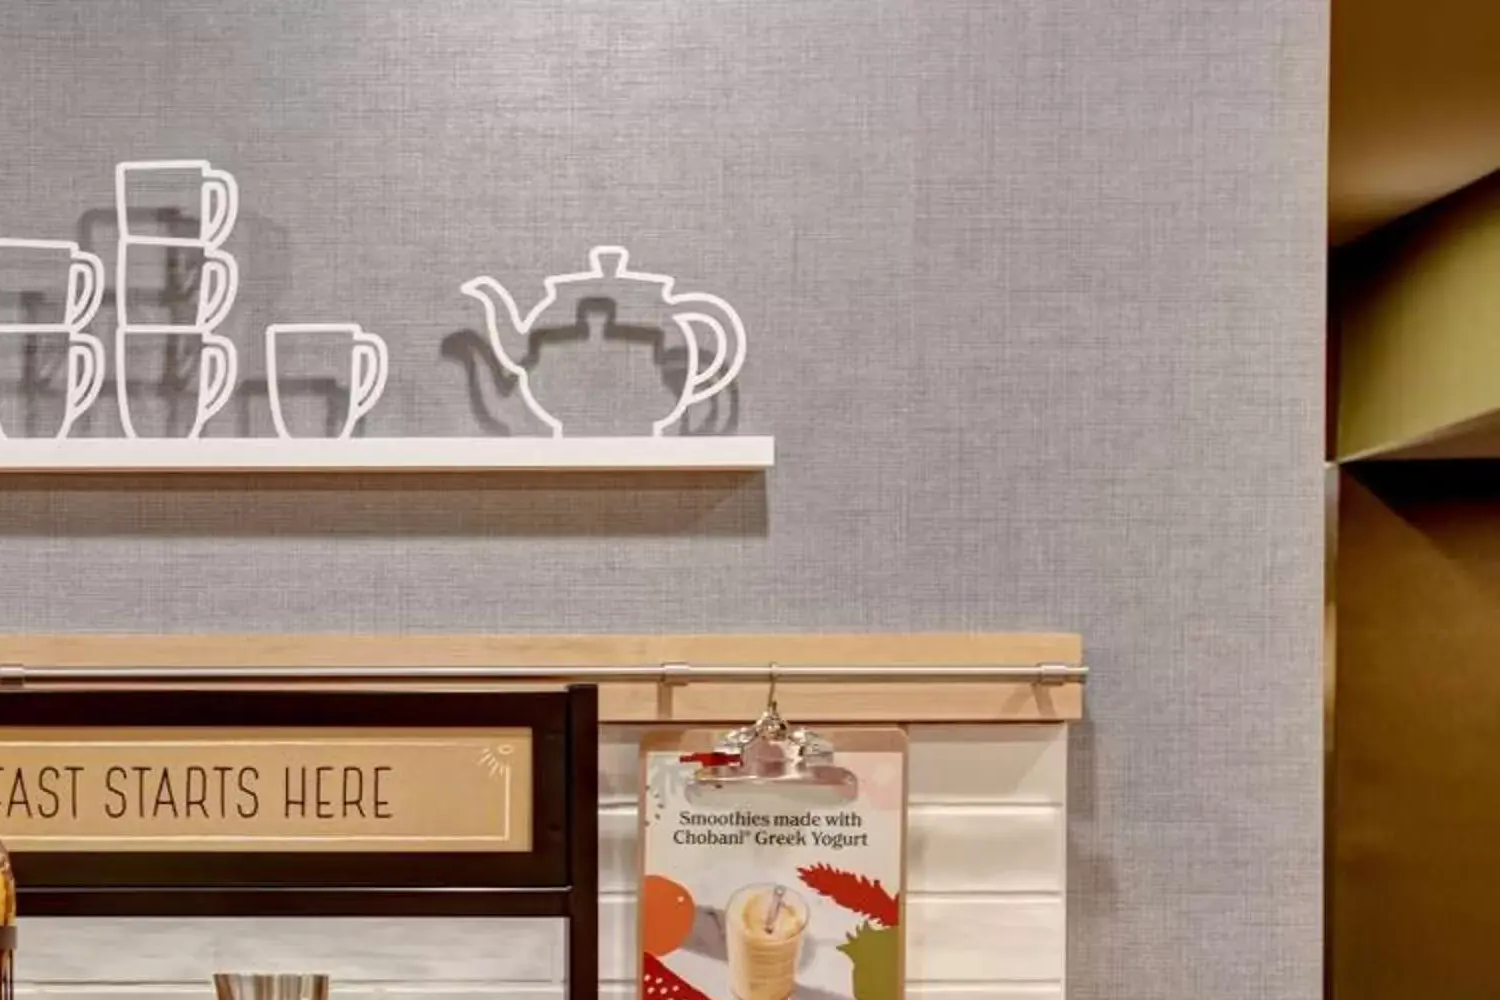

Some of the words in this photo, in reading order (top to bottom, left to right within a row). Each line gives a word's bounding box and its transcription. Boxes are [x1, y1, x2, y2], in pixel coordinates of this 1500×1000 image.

[105, 766, 259, 819] STARTS
[284, 766, 393, 819] HERE
[679, 811, 770, 827] Smoothies
[774, 812, 820, 827] made
[825, 812, 862, 827] with
[755, 831, 806, 846] Greek
[812, 831, 868, 849] Yogurt
